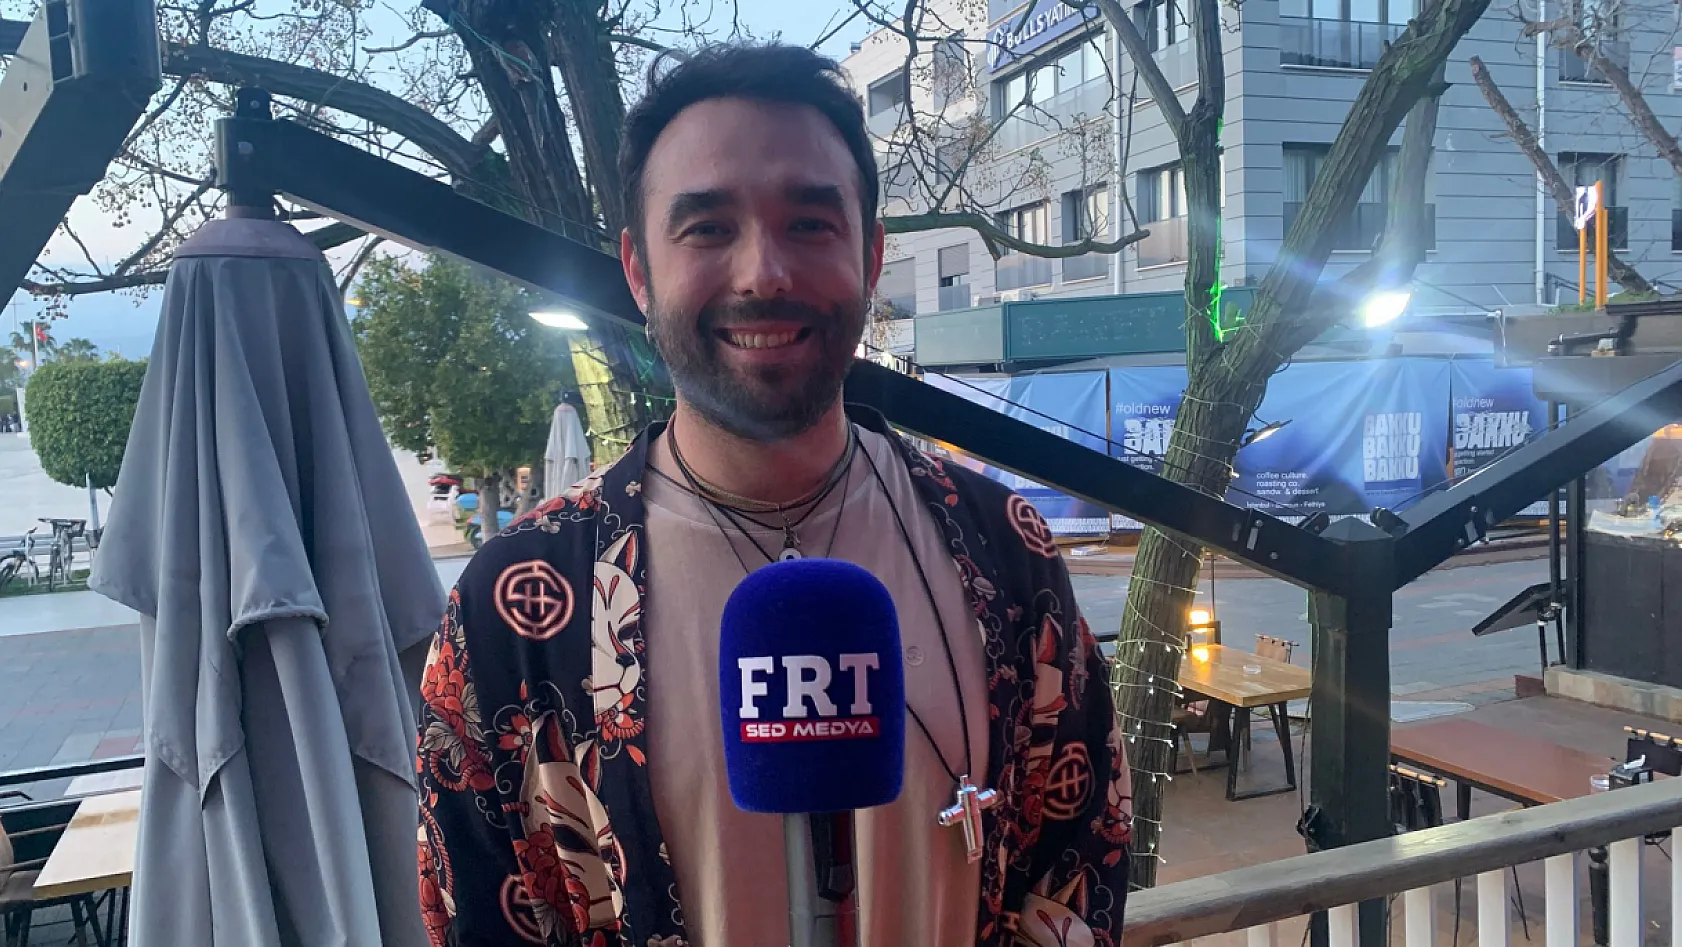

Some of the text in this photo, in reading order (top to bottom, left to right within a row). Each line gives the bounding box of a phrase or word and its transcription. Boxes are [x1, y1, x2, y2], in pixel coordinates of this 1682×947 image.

[1115, 403, 1171, 415] #oldnew
[1256, 472, 1279, 480] coffee
[1256, 481, 1287, 489] roasting
[738, 653, 881, 718] FRT
[745, 721, 874, 738] SED MEDYA
